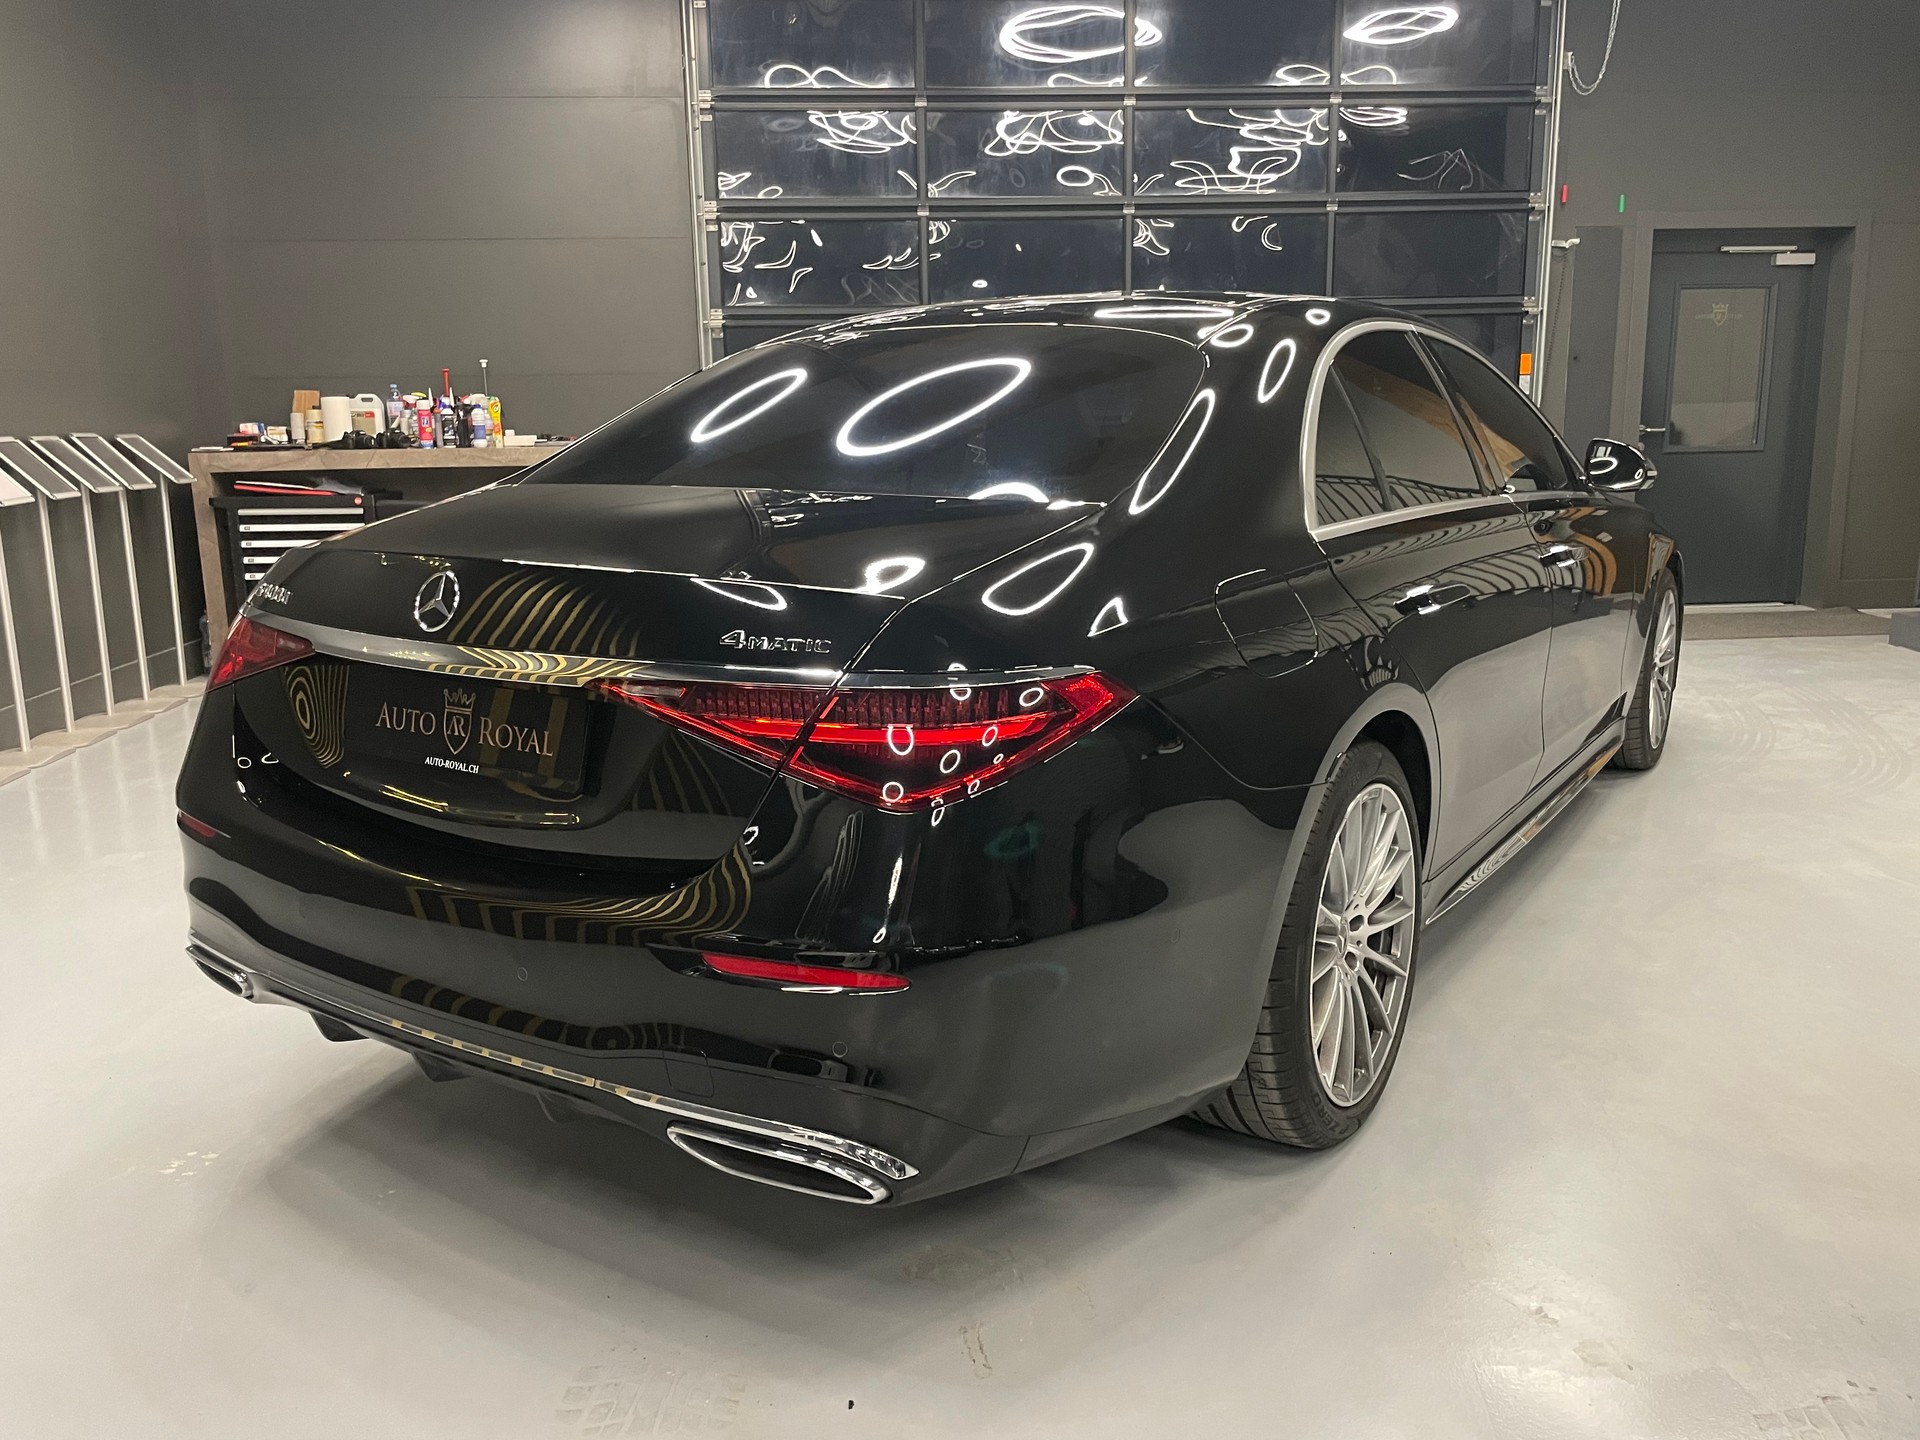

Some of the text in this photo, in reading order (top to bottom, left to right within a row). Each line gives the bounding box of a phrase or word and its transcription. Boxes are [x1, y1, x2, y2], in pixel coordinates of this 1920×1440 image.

[720, 629, 831, 653] 4MATIC
[376, 702, 436, 735] AUTO
[478, 716, 553, 756] ROYAL
[424, 756, 479, 774] AUTO-ROYAL.CH
